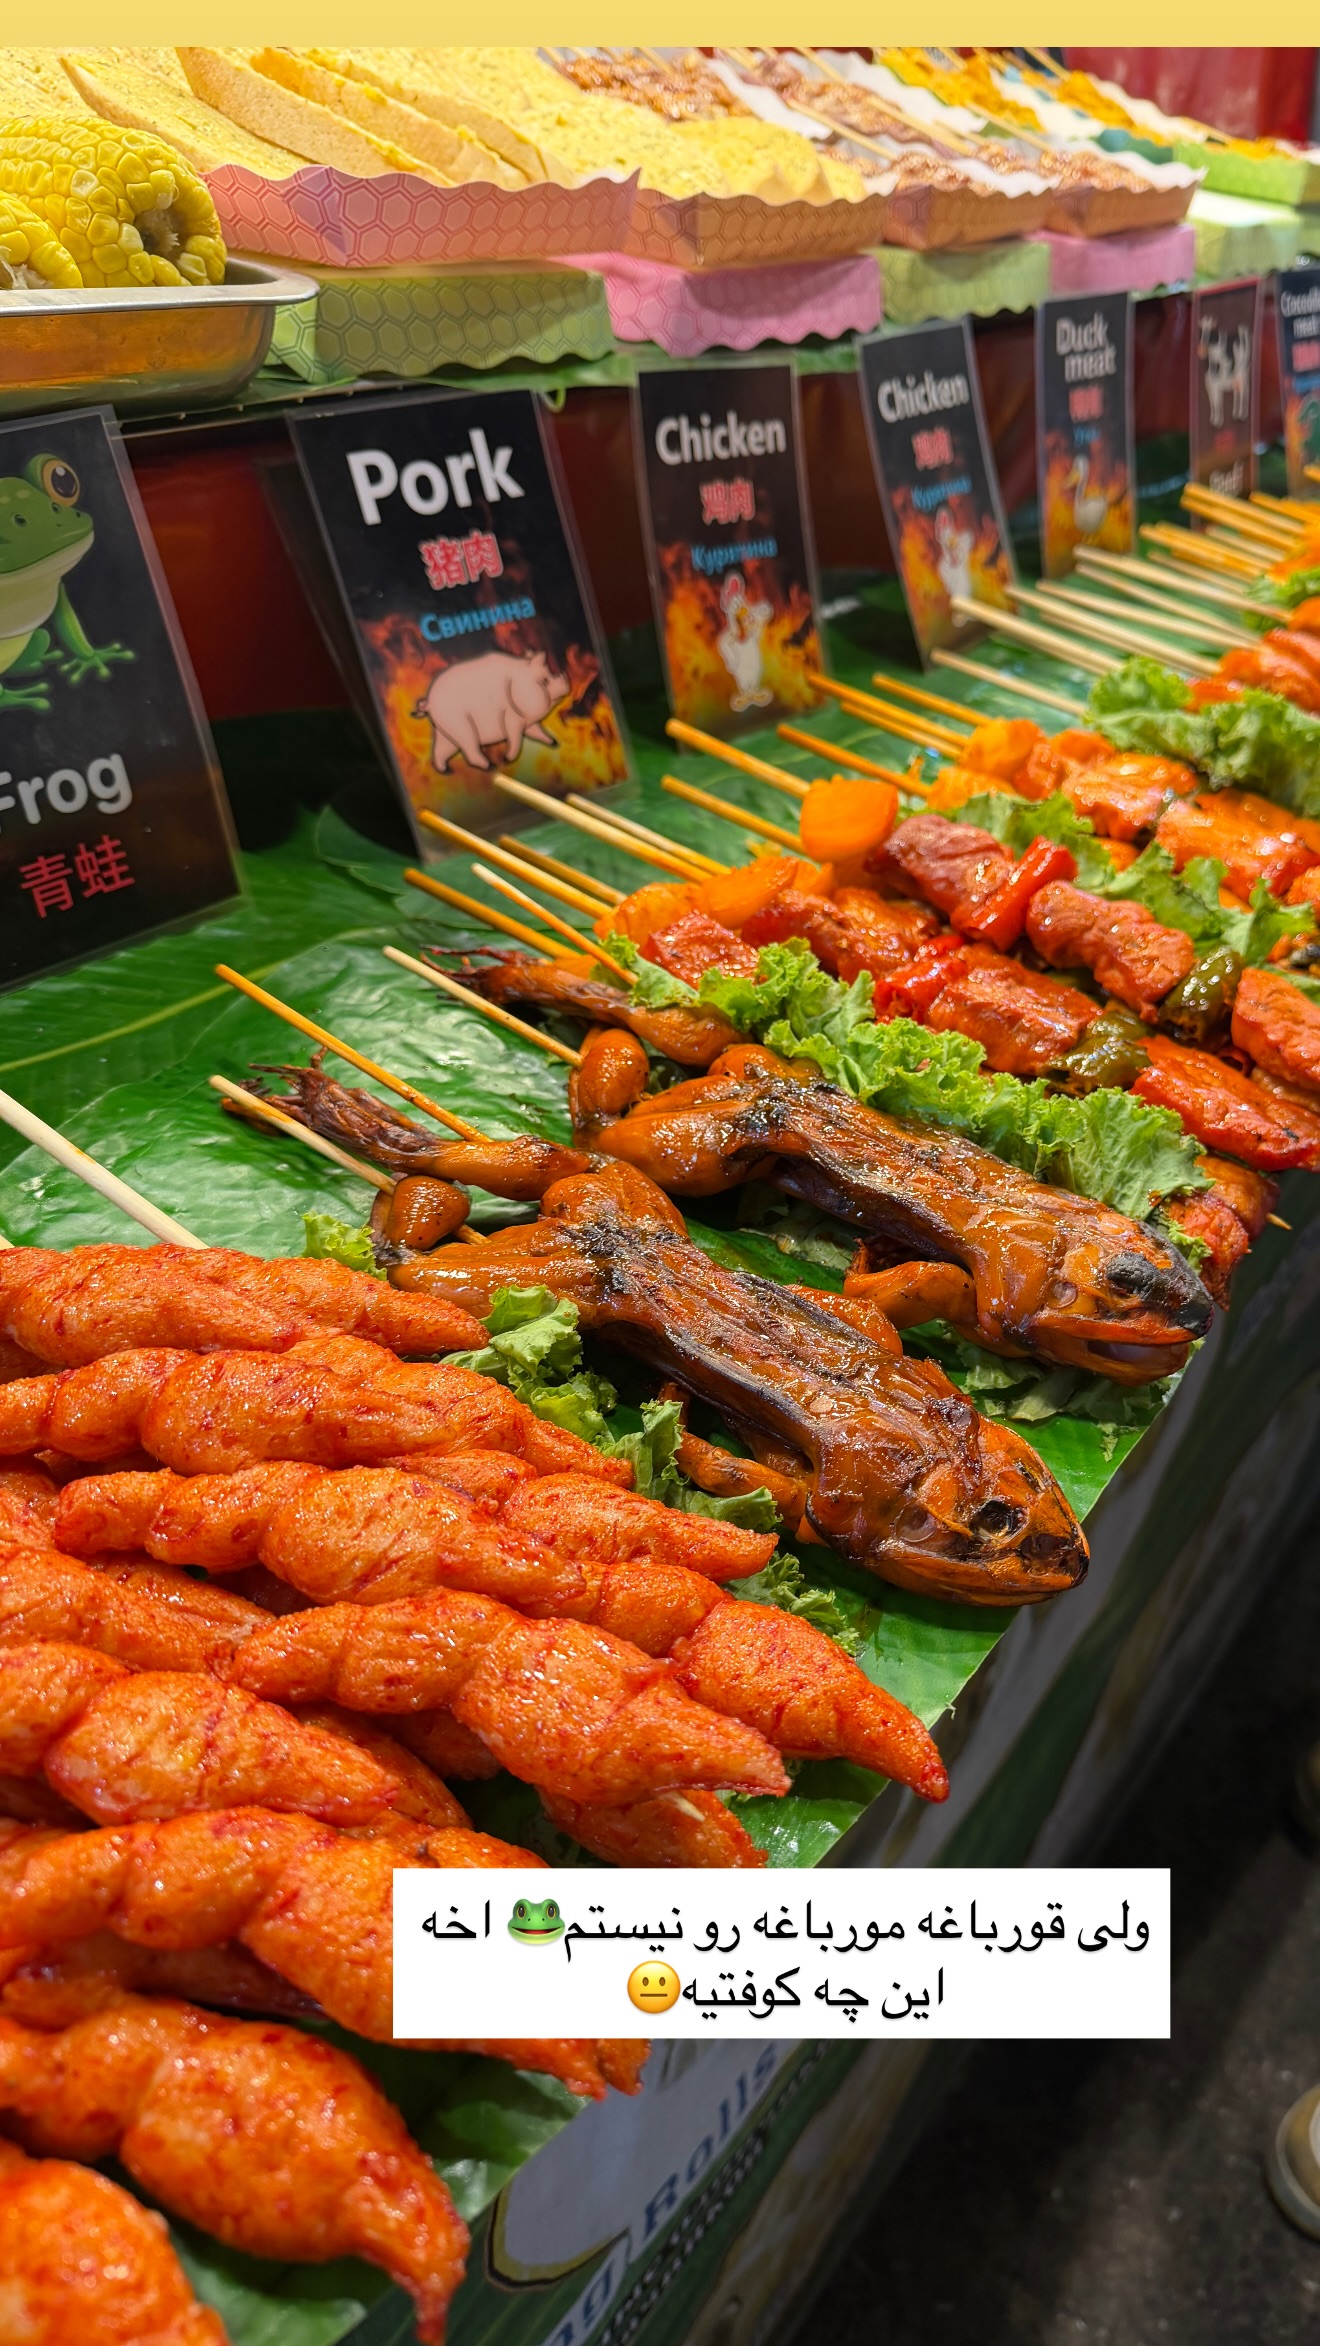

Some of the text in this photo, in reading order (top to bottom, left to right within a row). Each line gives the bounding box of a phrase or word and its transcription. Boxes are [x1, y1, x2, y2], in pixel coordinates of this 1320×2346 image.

[1056, 311, 1109, 356] Duck
[1064, 344, 1116, 383] meat
[878, 369, 970, 423] Chicken
[655, 410, 787, 466] Chicken
[346, 427, 525, 526] Pork
[418, 528, 503, 591] 猪肉
[420, 596, 536, 642] Свинина
[19, 834, 136, 919] 青蛙
[643, 2042, 777, 2240] Rolls
